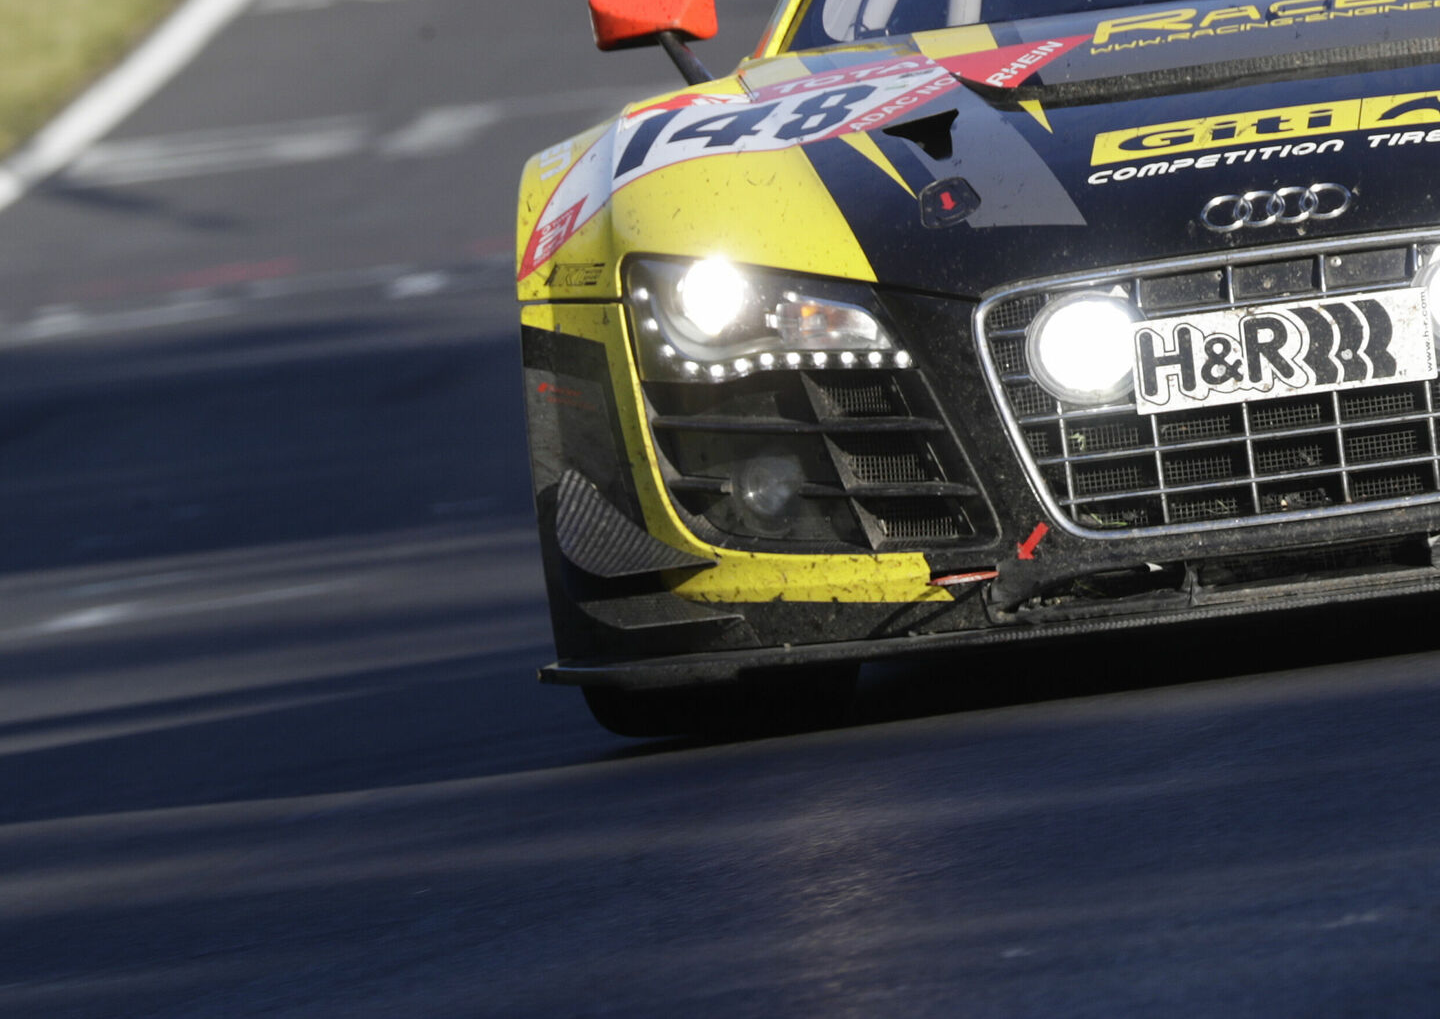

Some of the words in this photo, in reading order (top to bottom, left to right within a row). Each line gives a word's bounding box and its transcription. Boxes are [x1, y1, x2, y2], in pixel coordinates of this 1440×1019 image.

[613, 84, 878, 180] 148
[850, 96, 918, 133] ADAC
[1117, 108, 1338, 152] Giti
[1088, 138, 1345, 186] COMPETITION
[1136, 313, 1305, 403] H&R
[1419, 291, 1434, 372] www.h-r.com
